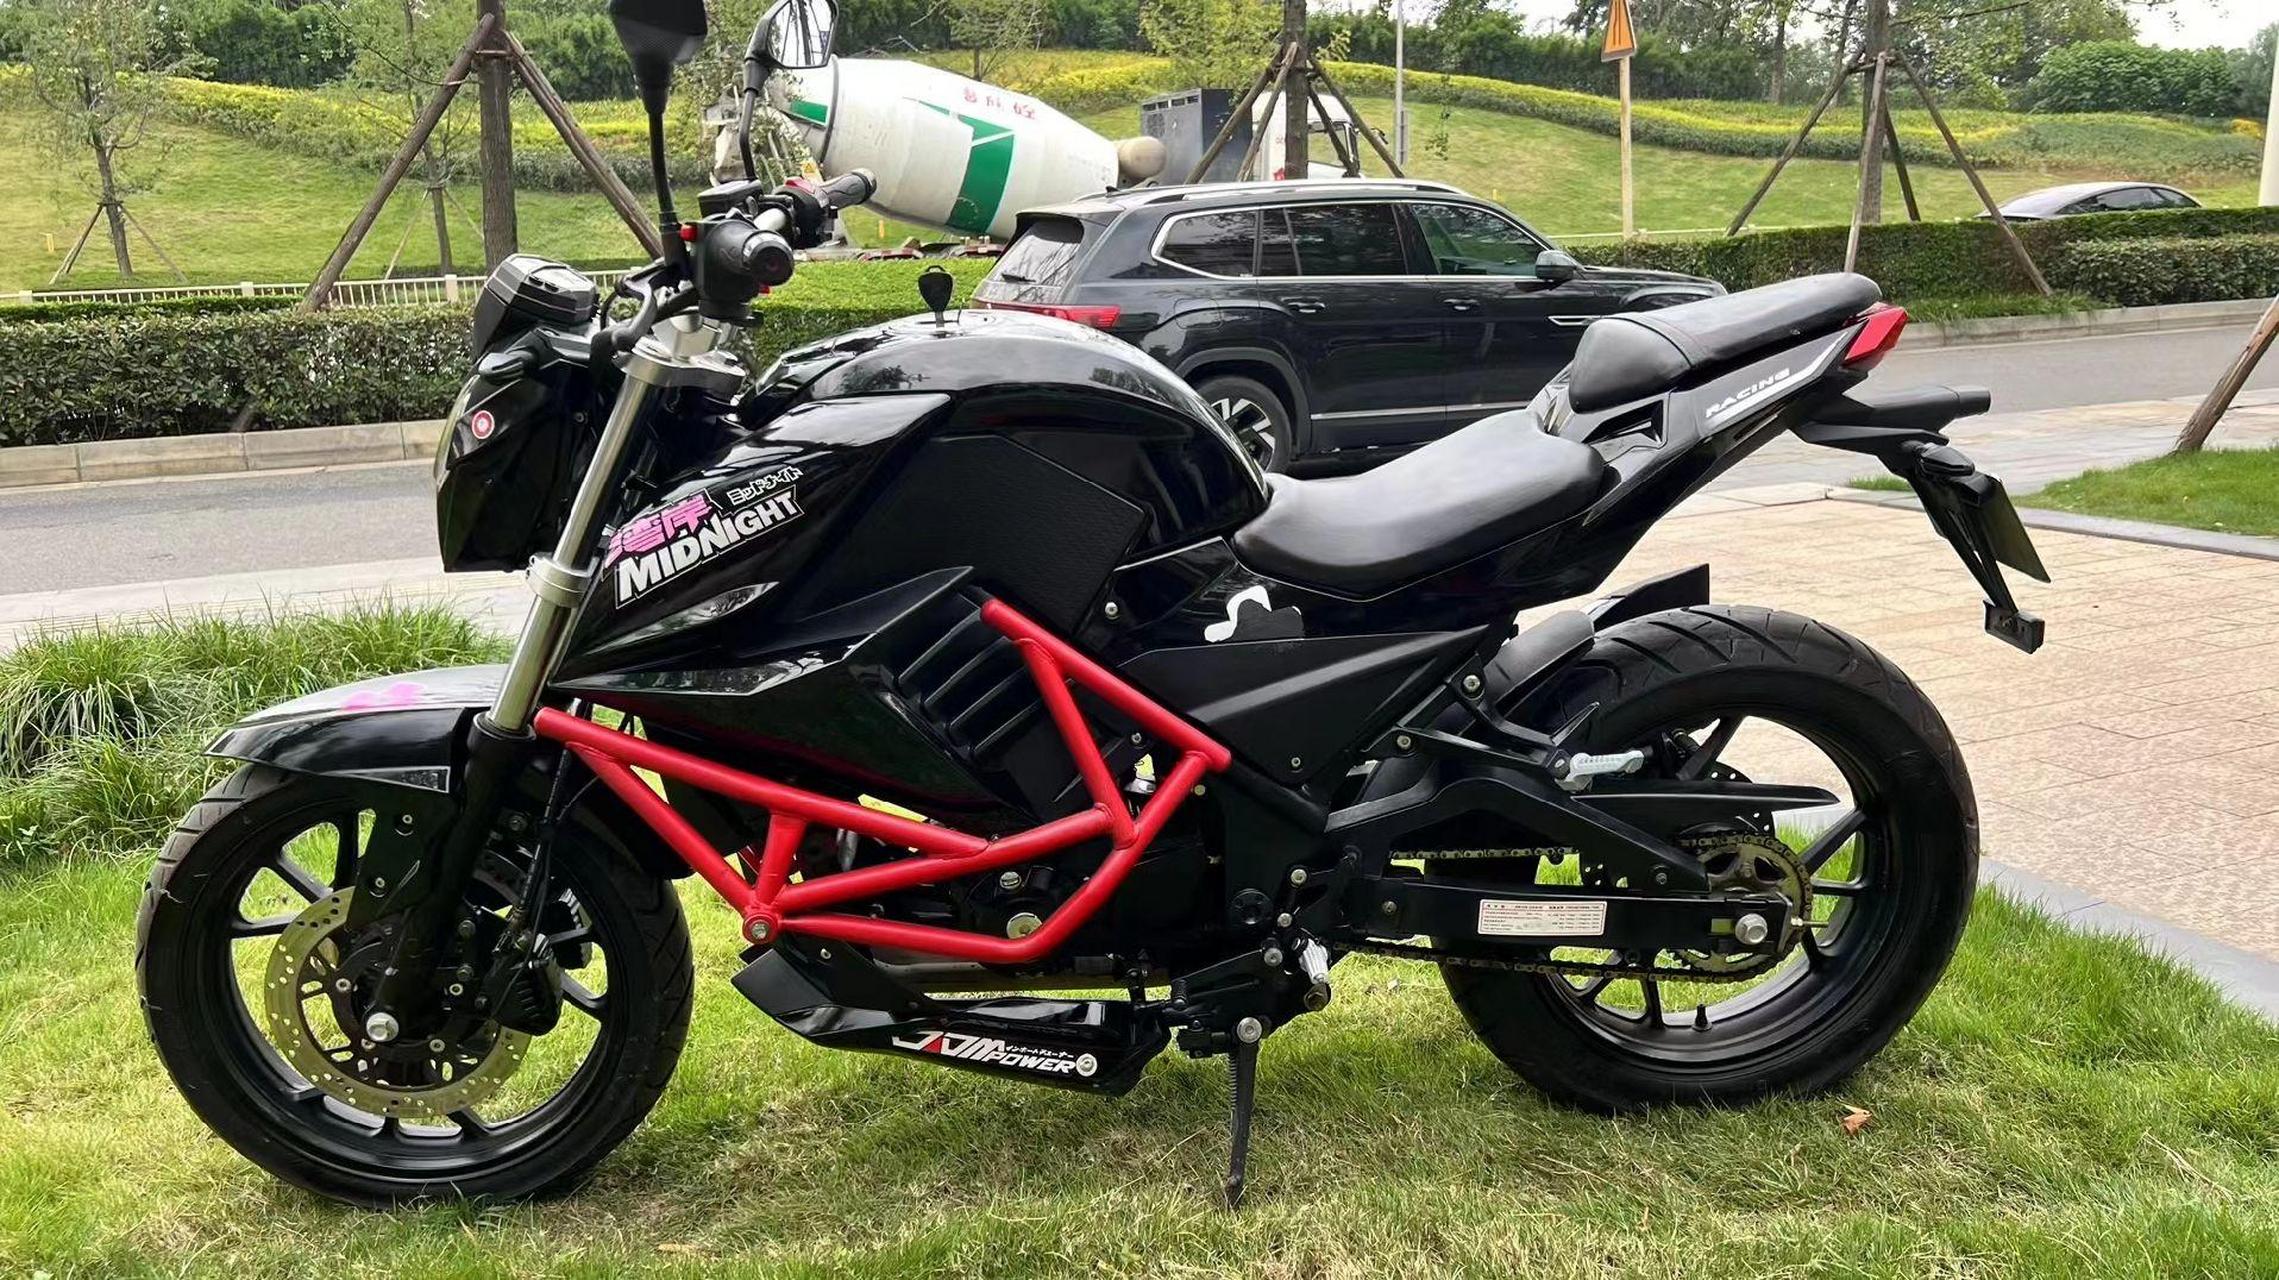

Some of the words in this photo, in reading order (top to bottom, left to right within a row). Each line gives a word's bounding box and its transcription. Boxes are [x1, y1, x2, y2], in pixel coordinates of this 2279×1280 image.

[1706, 368, 1789, 418] RACING
[619, 490, 799, 602] MIDNIGHT
[981, 1050, 1077, 1074] POWER
